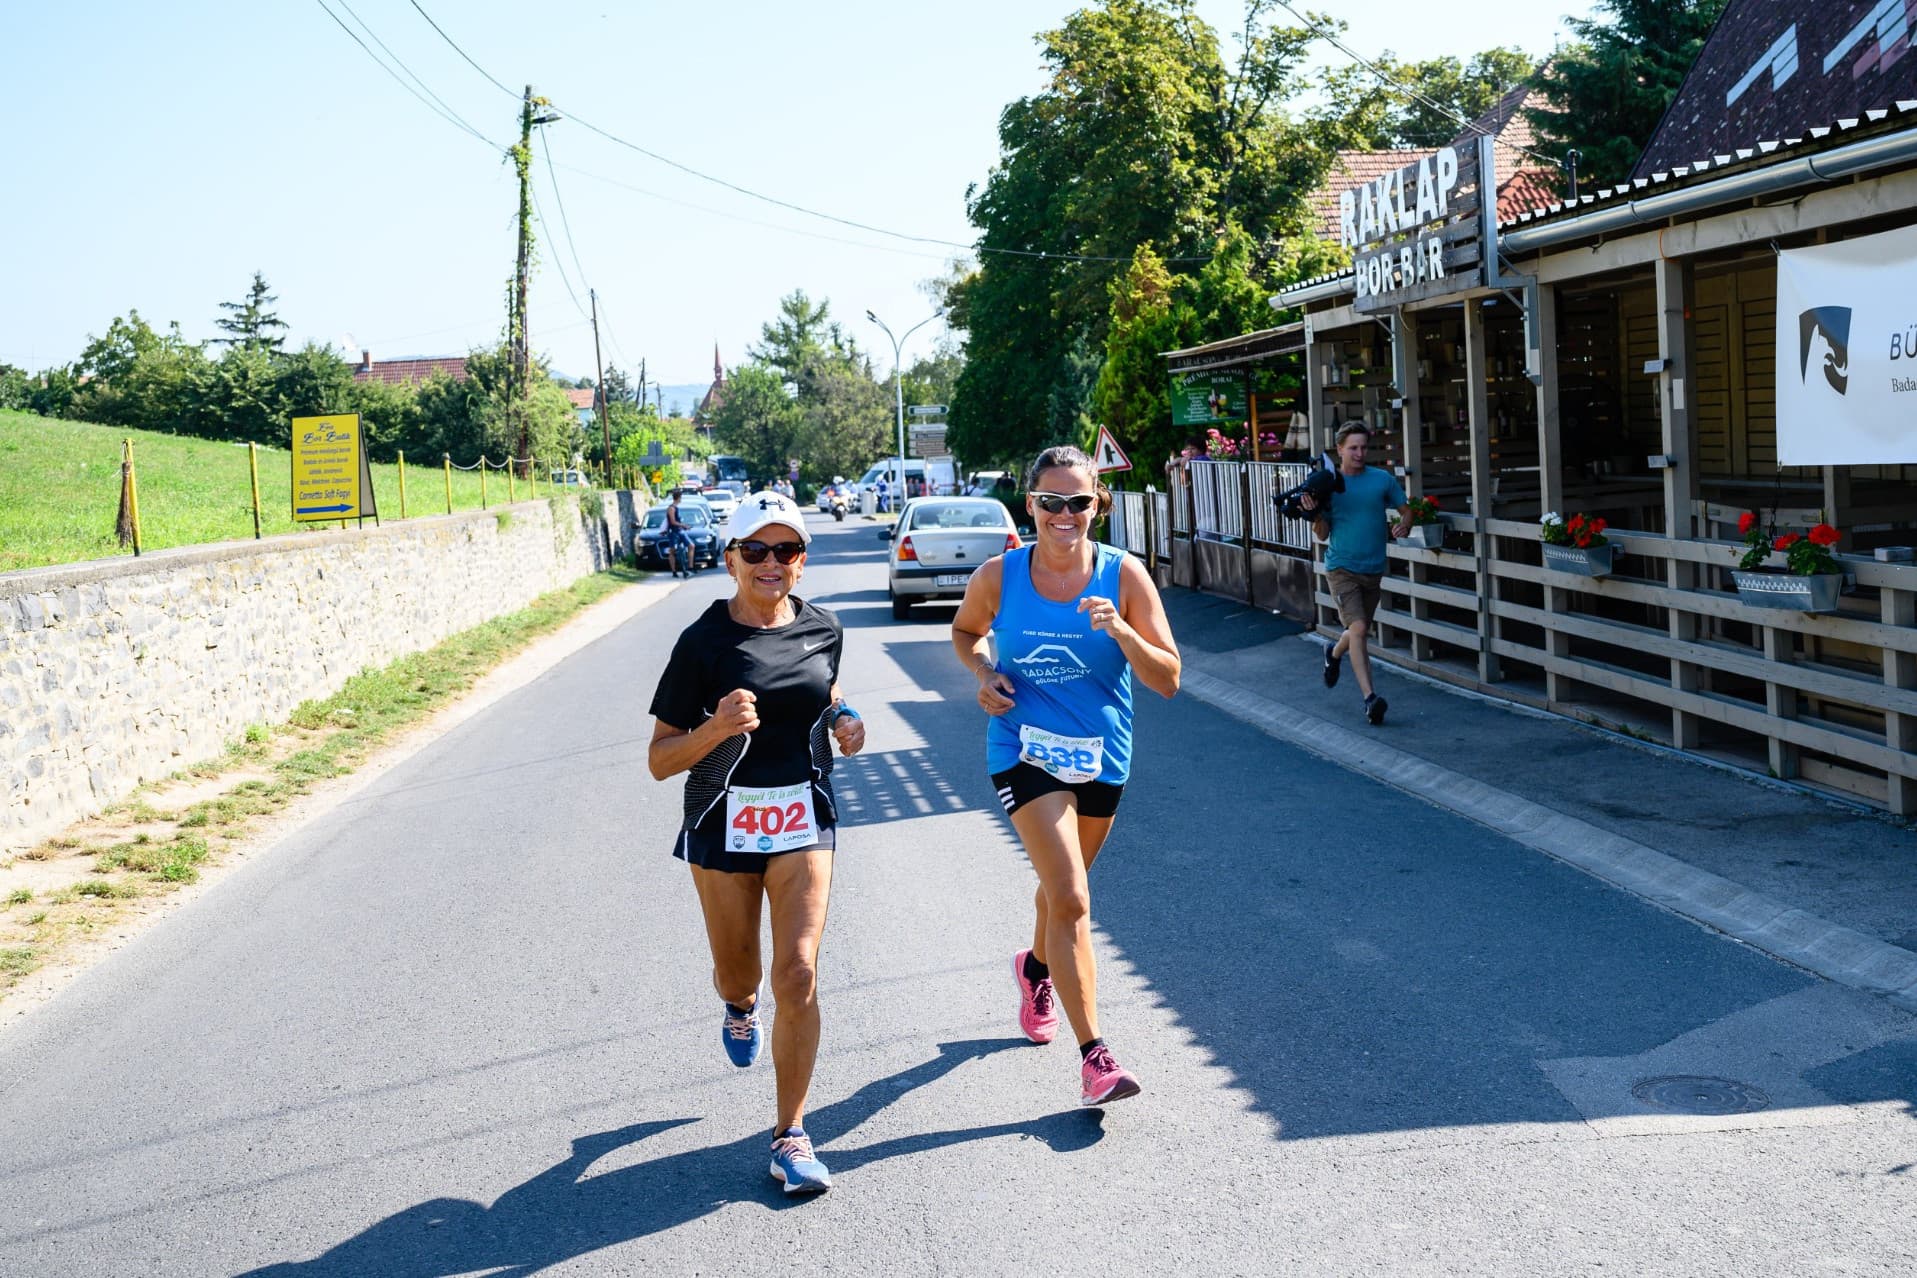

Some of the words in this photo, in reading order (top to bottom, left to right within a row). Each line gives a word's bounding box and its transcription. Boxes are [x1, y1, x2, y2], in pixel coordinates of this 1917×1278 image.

[1340, 146, 1459, 250] RAKLAP
[1356, 252, 1395, 299] BOR
[1891, 377, 1917, 393] Bada
[732, 801, 809, 836] 402
